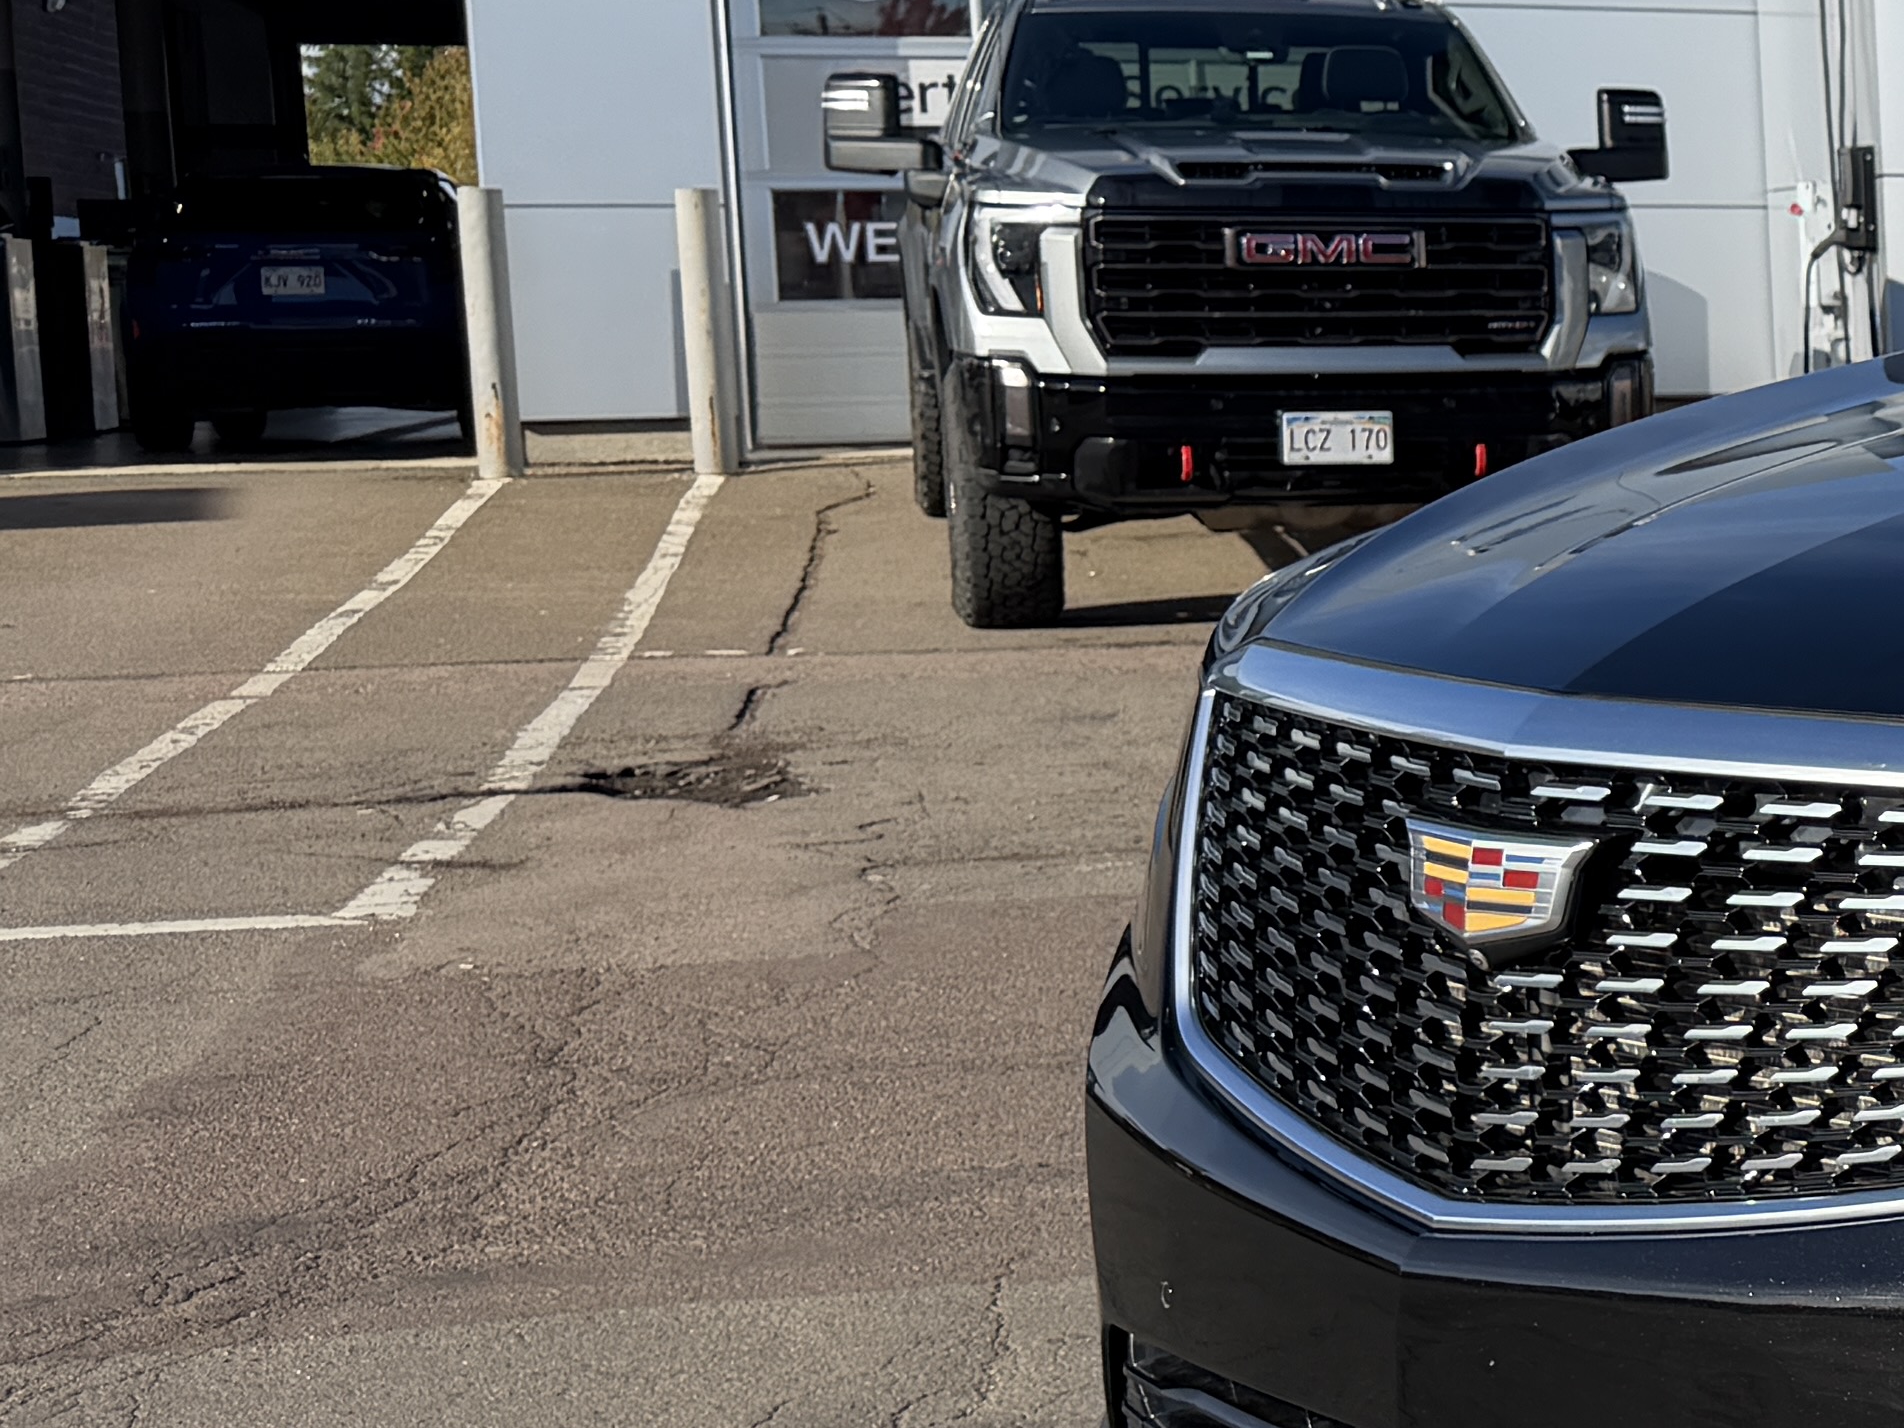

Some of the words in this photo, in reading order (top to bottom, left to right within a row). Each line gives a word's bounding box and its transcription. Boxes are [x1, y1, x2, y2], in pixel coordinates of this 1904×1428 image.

[804, 220, 898, 264] WE
[1241, 232, 1413, 264] GMC
[1289, 427, 1332, 452] LCZ
[1350, 427, 1388, 452] 170
